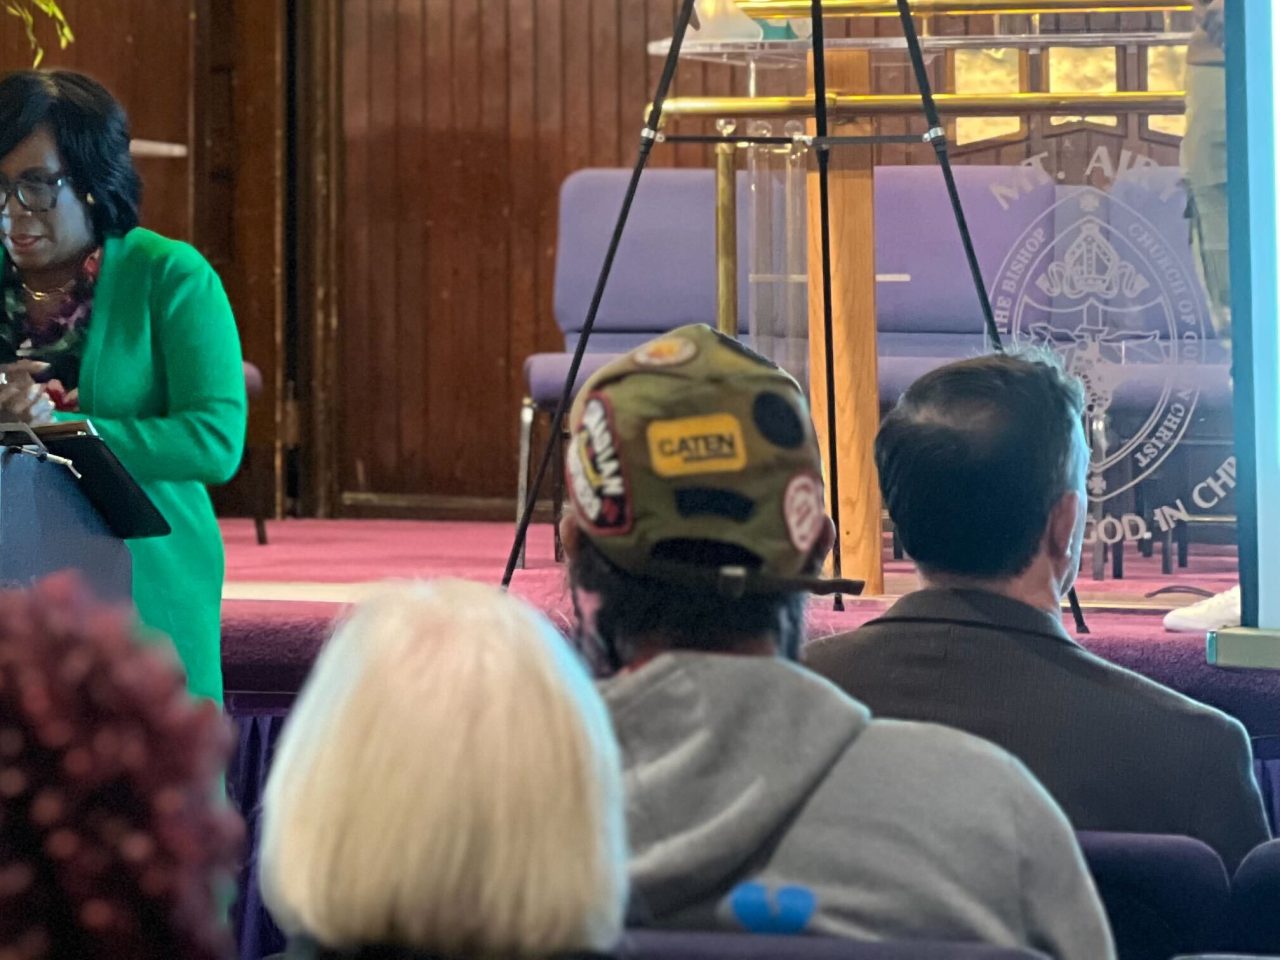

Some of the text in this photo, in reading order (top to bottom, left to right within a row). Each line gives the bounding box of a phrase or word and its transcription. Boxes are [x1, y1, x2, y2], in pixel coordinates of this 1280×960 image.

[1001, 226, 1046, 295] BISHOP
[1127, 221, 1186, 298] CHURCH
[1133, 404, 1188, 469] CHRIST
